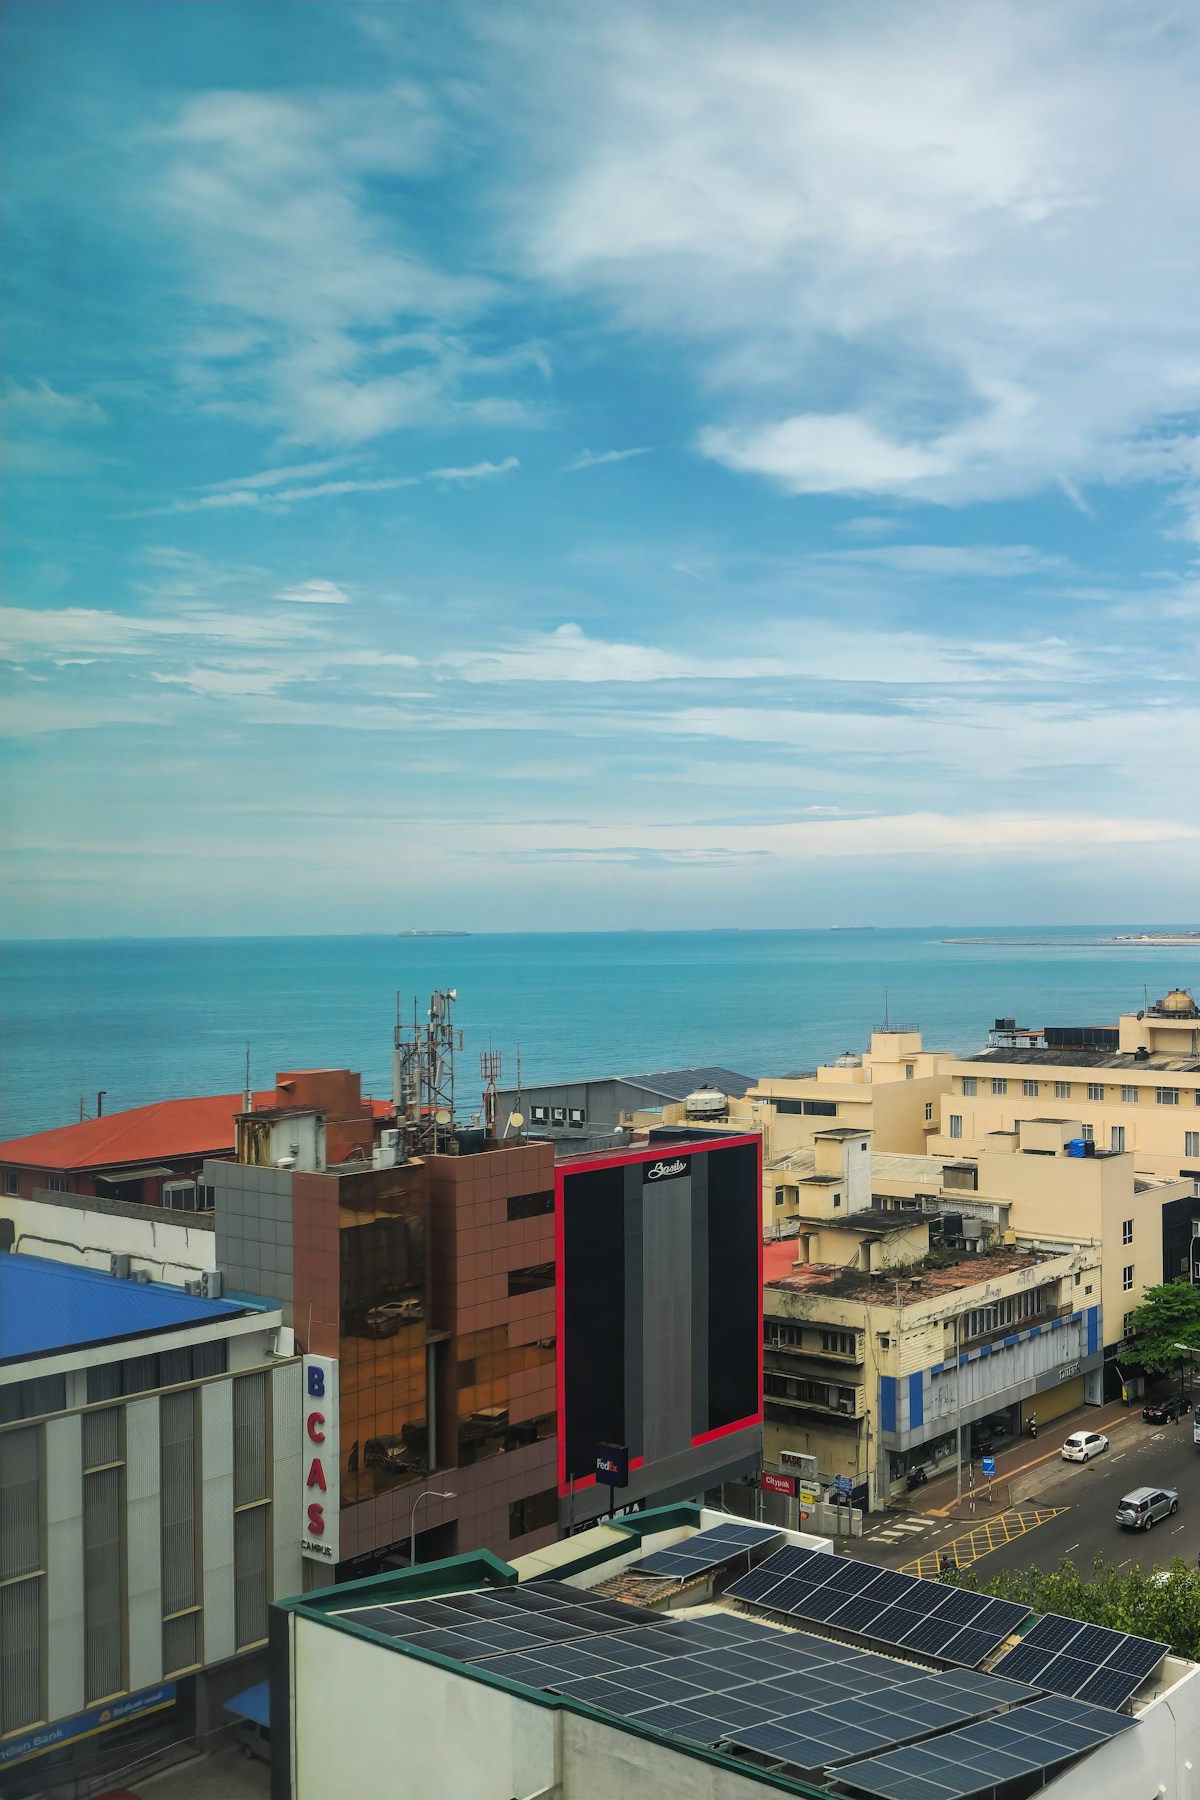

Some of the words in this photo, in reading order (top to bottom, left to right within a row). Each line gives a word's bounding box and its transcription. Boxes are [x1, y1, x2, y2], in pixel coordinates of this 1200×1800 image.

[648, 1159, 687, 1179] Basils
[307, 1365, 327, 1535] BCAS
[596, 1458, 618, 1473] FedEx
[765, 1476, 790, 1489] Citypak
[301, 1539, 332, 1557] CAMPUS
[33, 1729, 64, 1747] Bank
